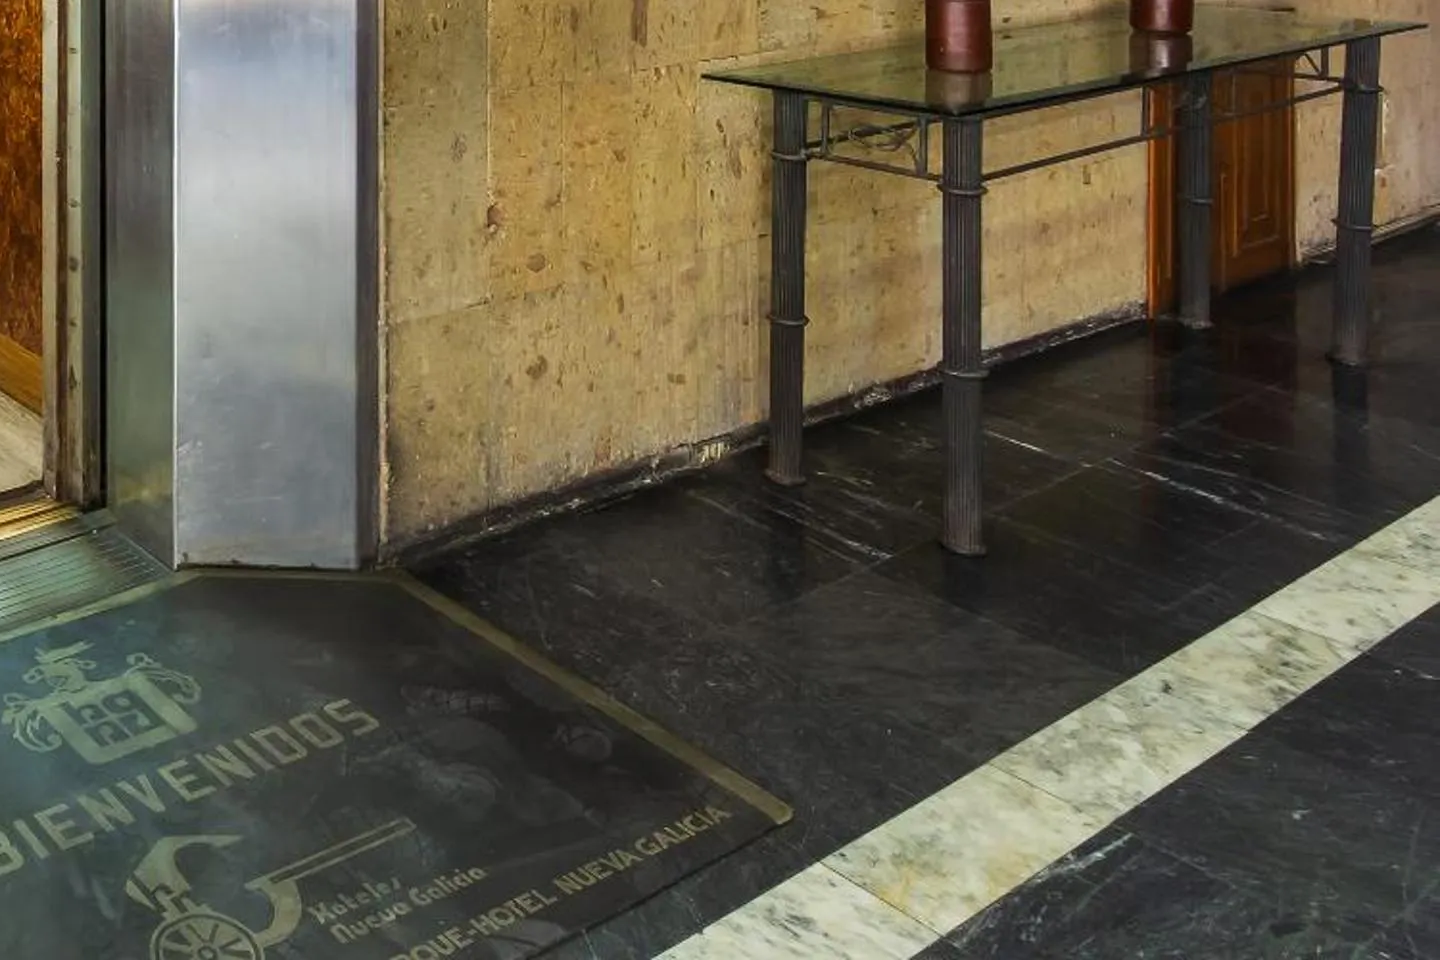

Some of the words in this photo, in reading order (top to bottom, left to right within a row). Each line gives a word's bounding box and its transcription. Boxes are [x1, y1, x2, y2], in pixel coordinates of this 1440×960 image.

[551, 848, 644, 895] NUEVA
[633, 804, 734, 856] GALICIA
[408, 867, 488, 906] Galicia
